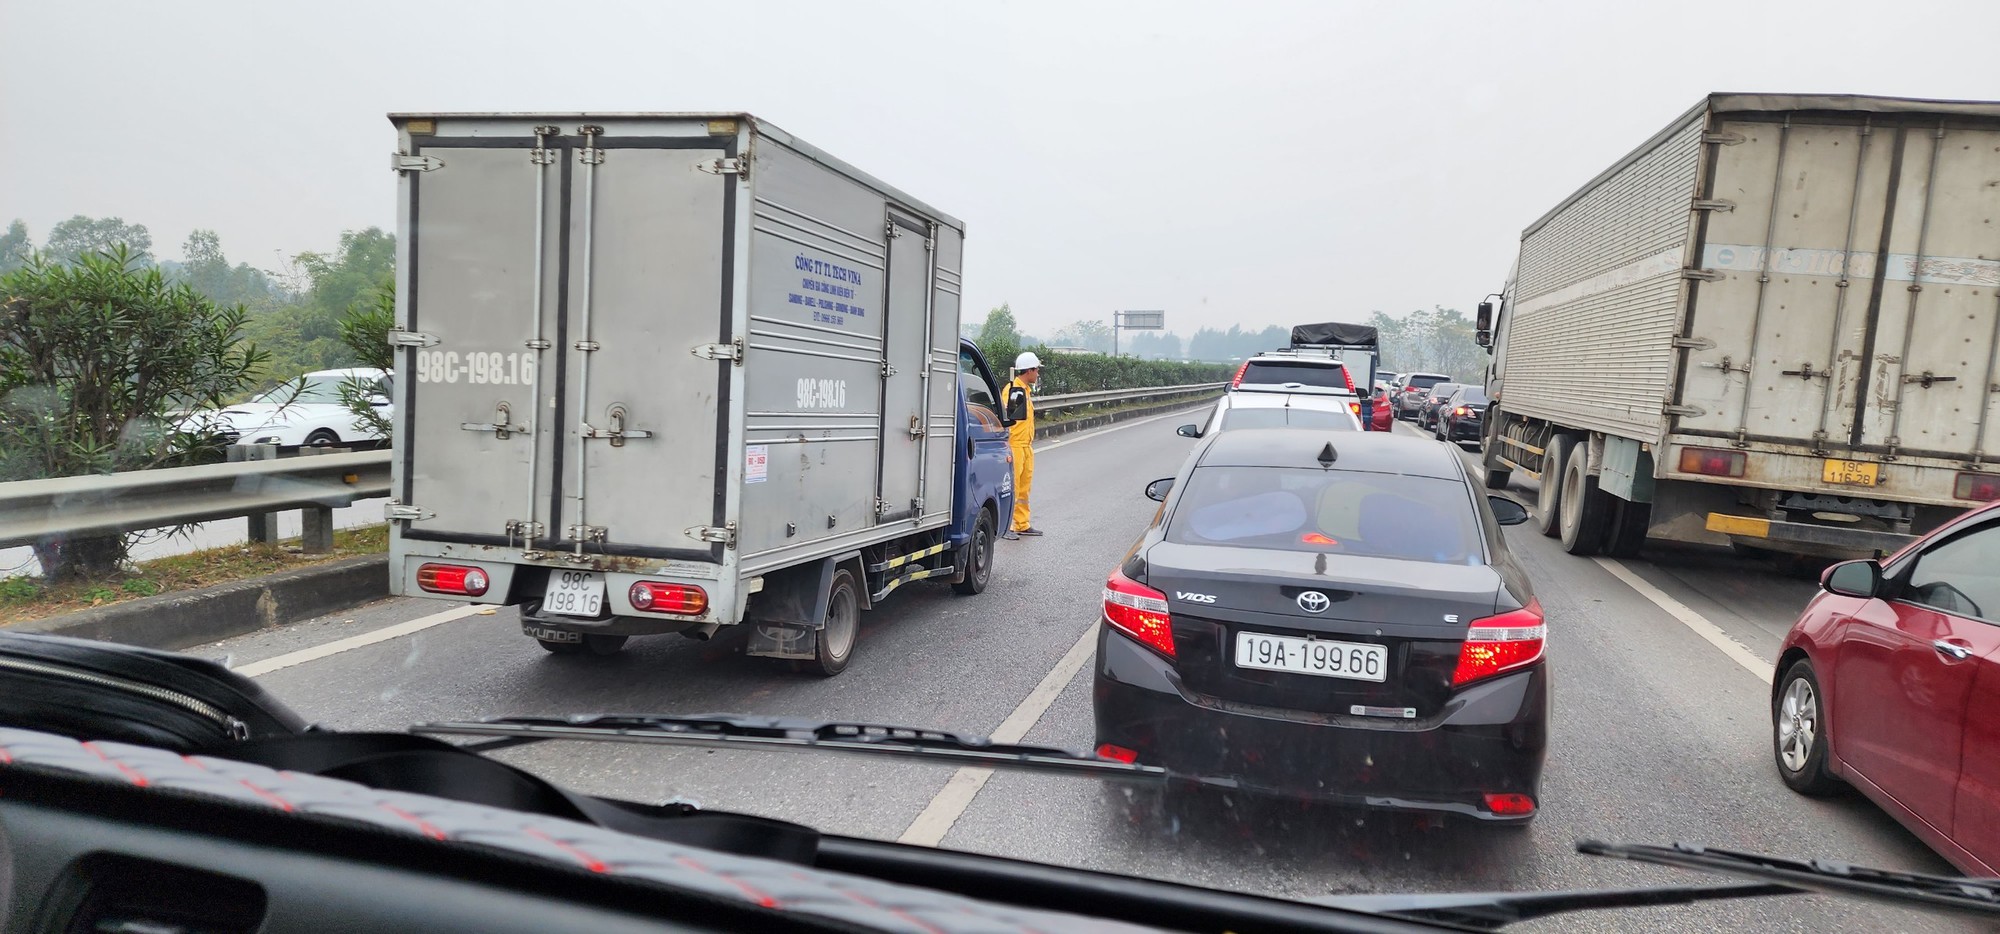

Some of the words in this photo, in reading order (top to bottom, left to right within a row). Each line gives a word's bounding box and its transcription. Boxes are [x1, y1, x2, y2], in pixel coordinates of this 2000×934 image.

[814, 260, 822, 274] TY
[848, 270, 862, 286] VINA
[418, 351, 533, 386] 98C-198.16
[797, 378, 846, 408] 98C-198.16
[1842, 462, 1862, 472] 19C
[561, 572, 592, 591] 98C
[548, 592, 599, 612] 198.16
[1176, 591, 1217, 604] VIOS
[1443, 614, 1459, 624] E
[1247, 638, 1379, 675] 19A-199.66
